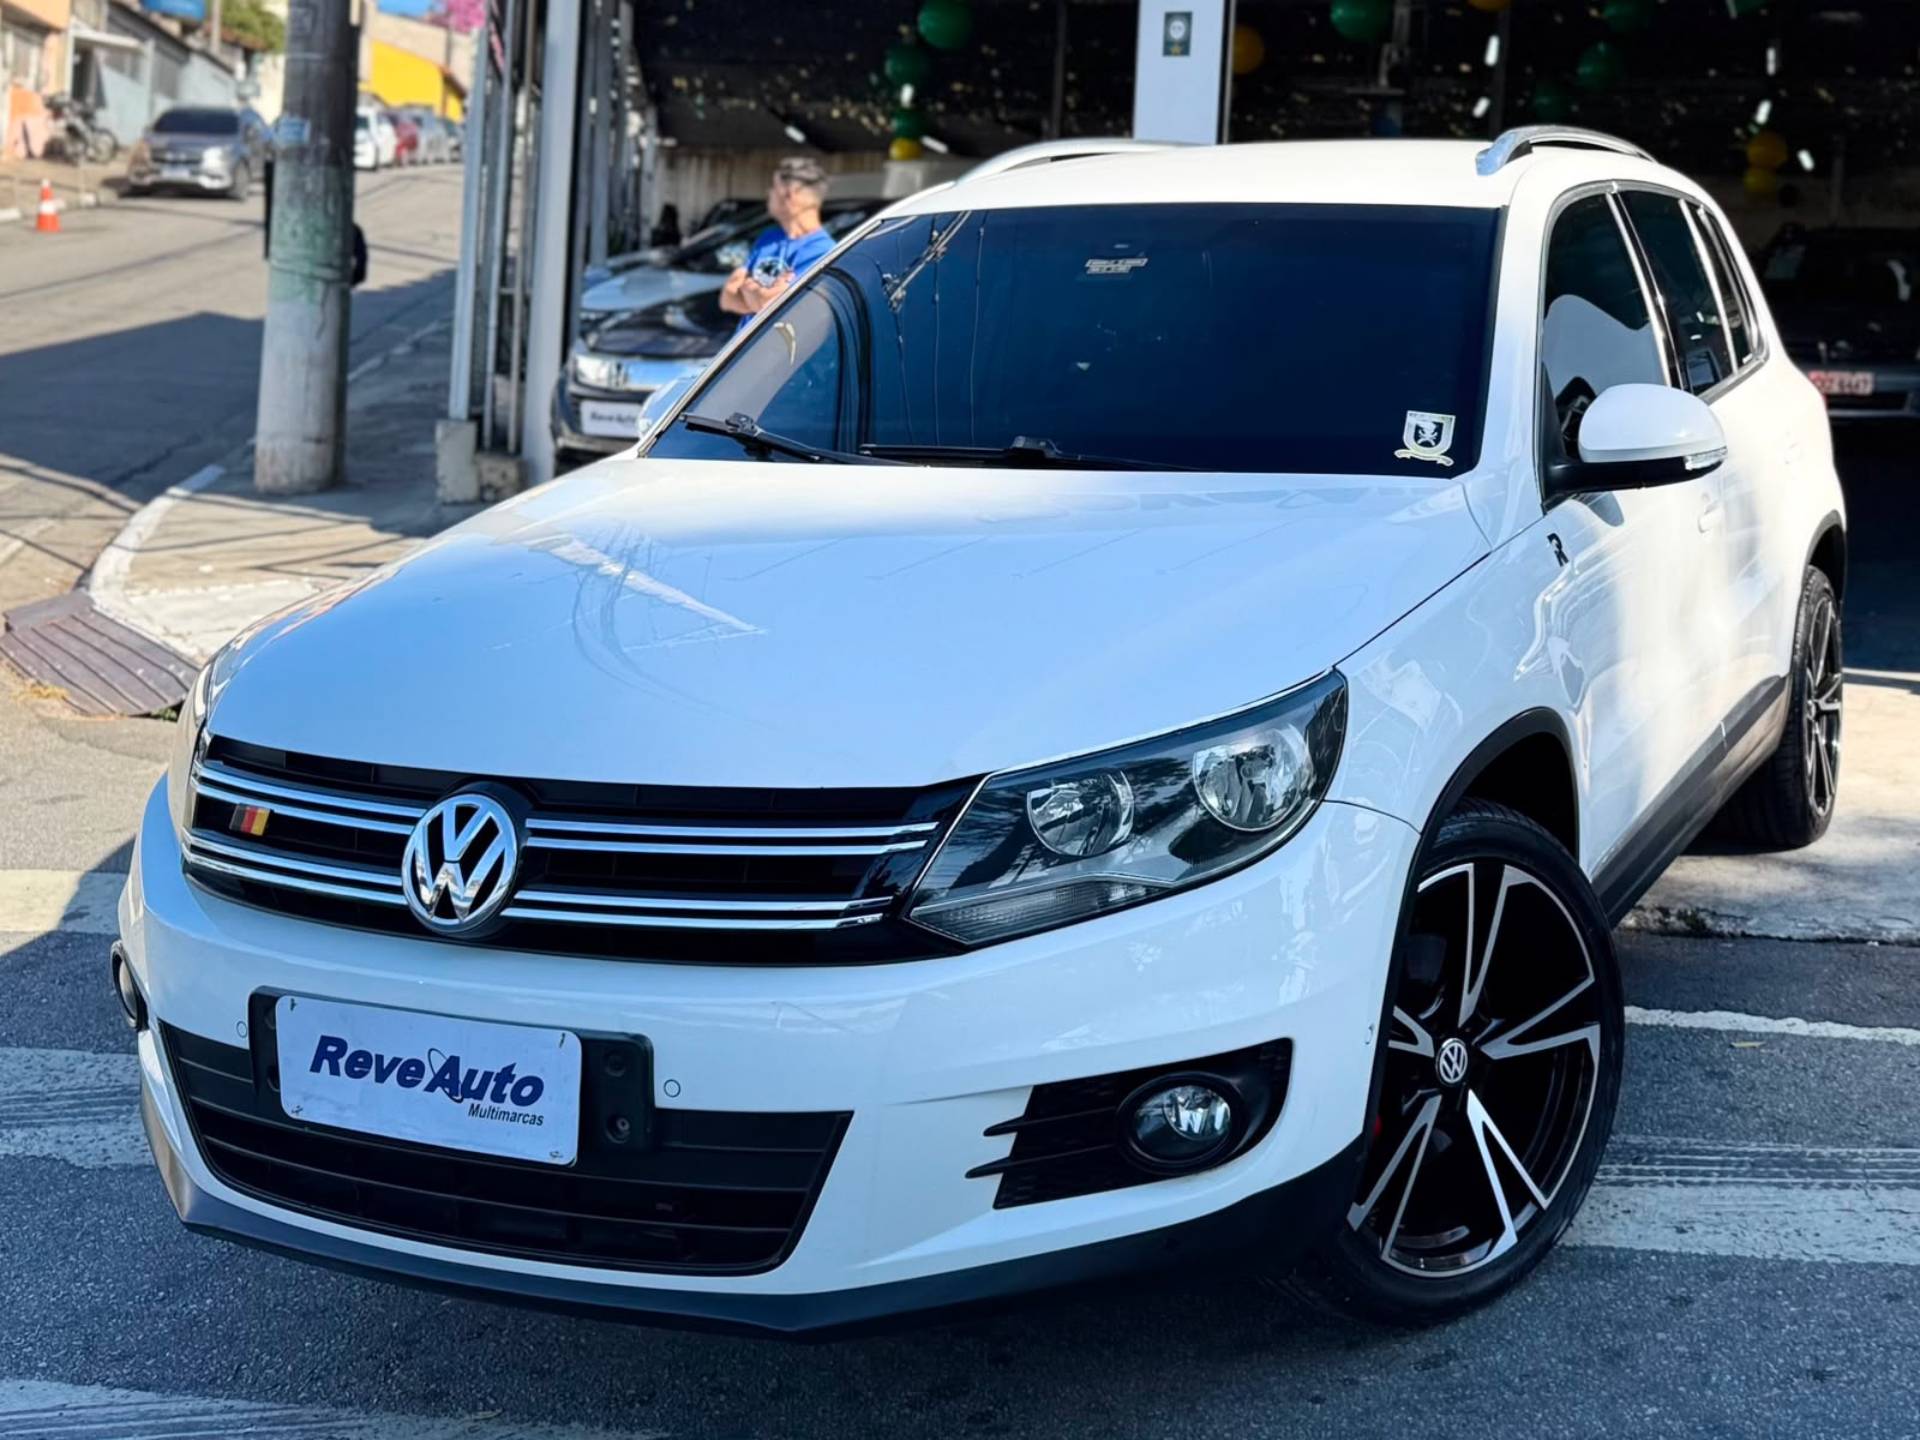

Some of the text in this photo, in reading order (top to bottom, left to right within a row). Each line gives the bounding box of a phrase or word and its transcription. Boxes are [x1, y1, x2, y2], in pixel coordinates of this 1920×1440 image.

[590, 411, 638, 424] ReveAut
[1547, 533, 1568, 567] R
[403, 795, 516, 927] VW
[1439, 1042, 1468, 1083] VW
[468, 1102, 544, 1126] Multimarcas
